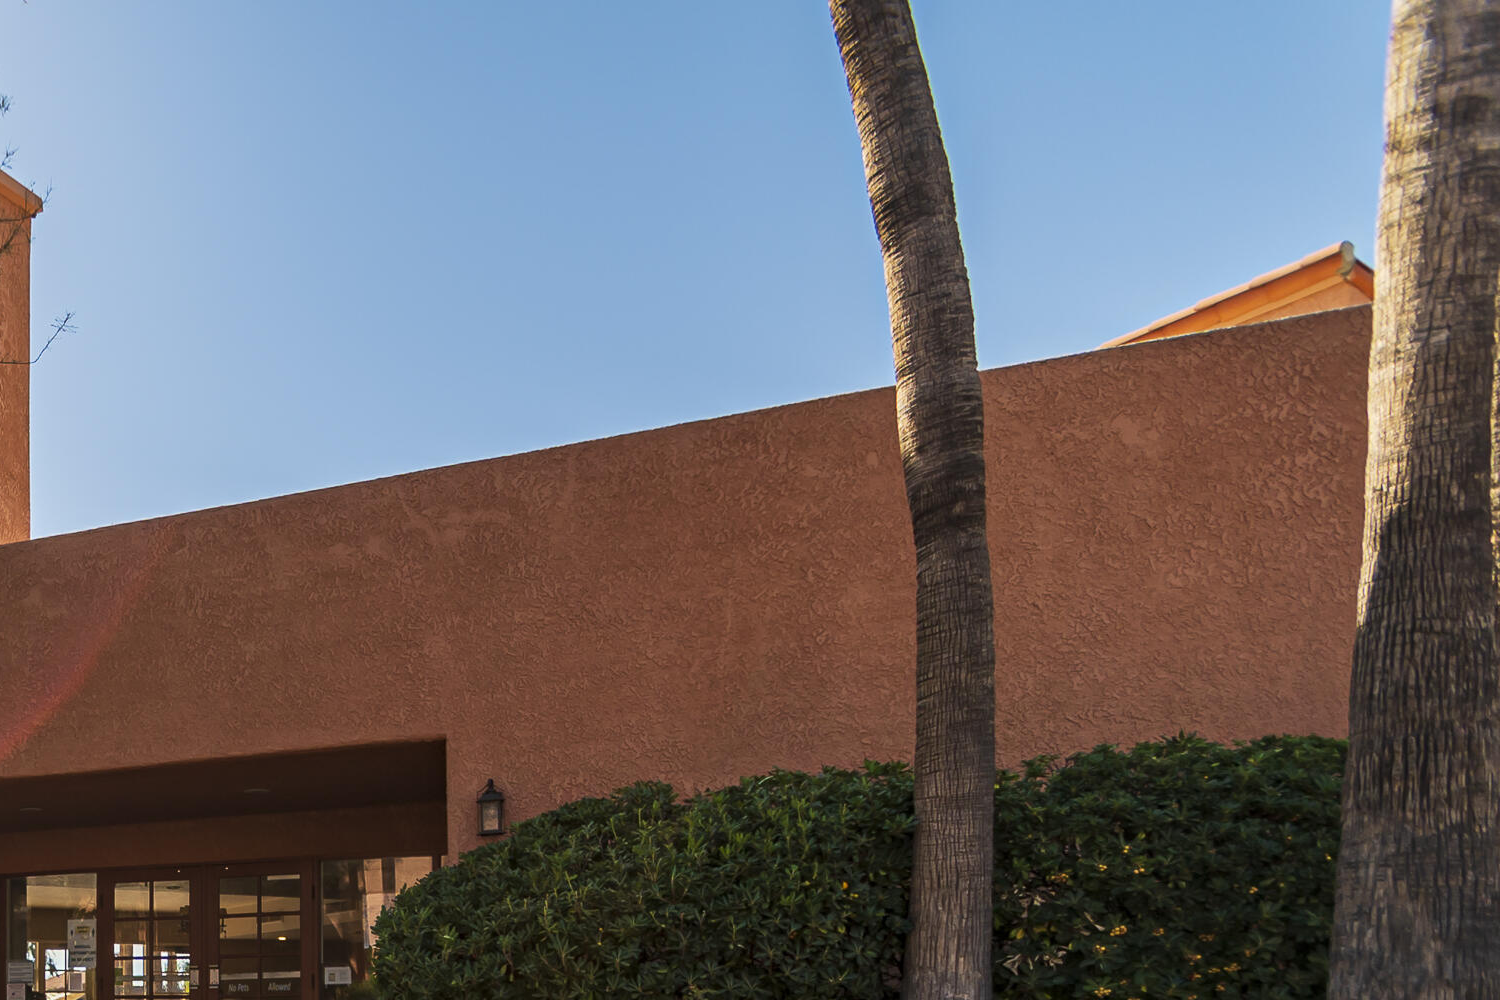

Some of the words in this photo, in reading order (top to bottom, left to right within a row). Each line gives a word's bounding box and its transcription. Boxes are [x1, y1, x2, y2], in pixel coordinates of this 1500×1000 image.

[228, 984, 237, 992] No
[238, 983, 250, 992] Pets
[267, 982, 292, 991] Allowed
